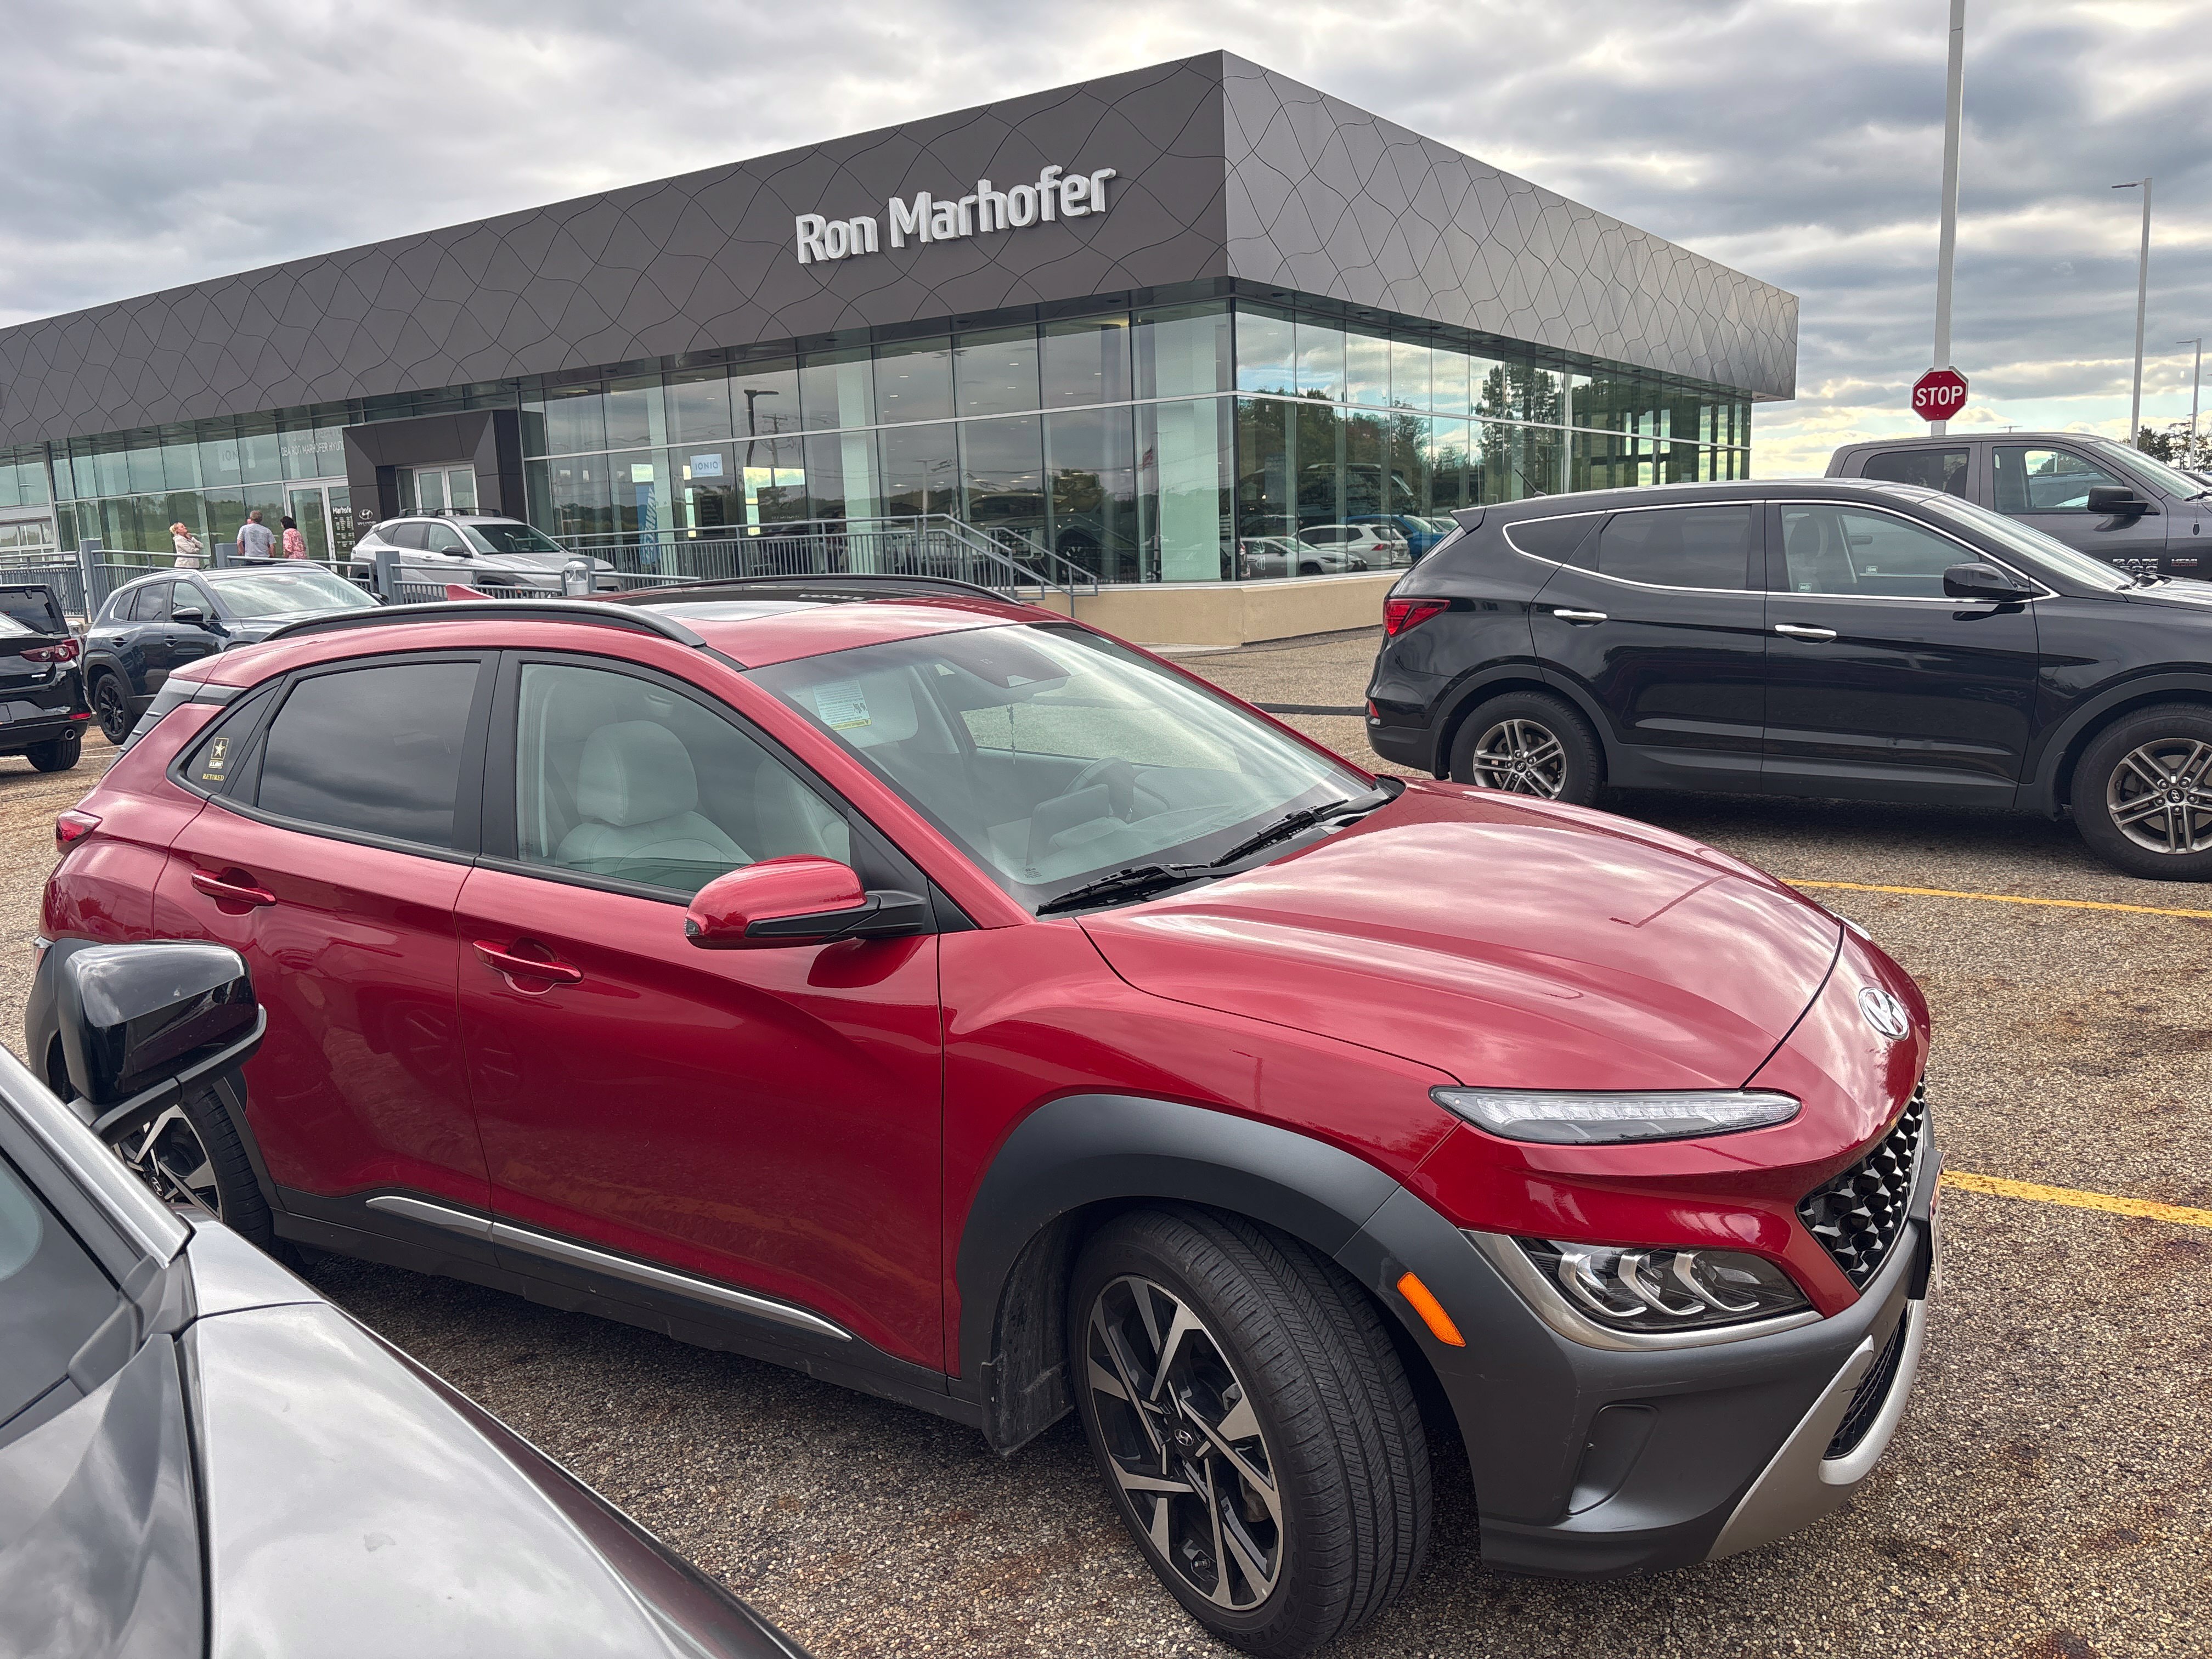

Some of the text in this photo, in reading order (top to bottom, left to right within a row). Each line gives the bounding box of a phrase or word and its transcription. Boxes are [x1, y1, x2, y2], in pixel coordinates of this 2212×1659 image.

[795, 165, 1116, 264] Ron Marhofer
[1915, 386, 1963, 407] STOP
[695, 461, 718, 470] IONIQ
[332, 506, 352, 514] Marhofe
